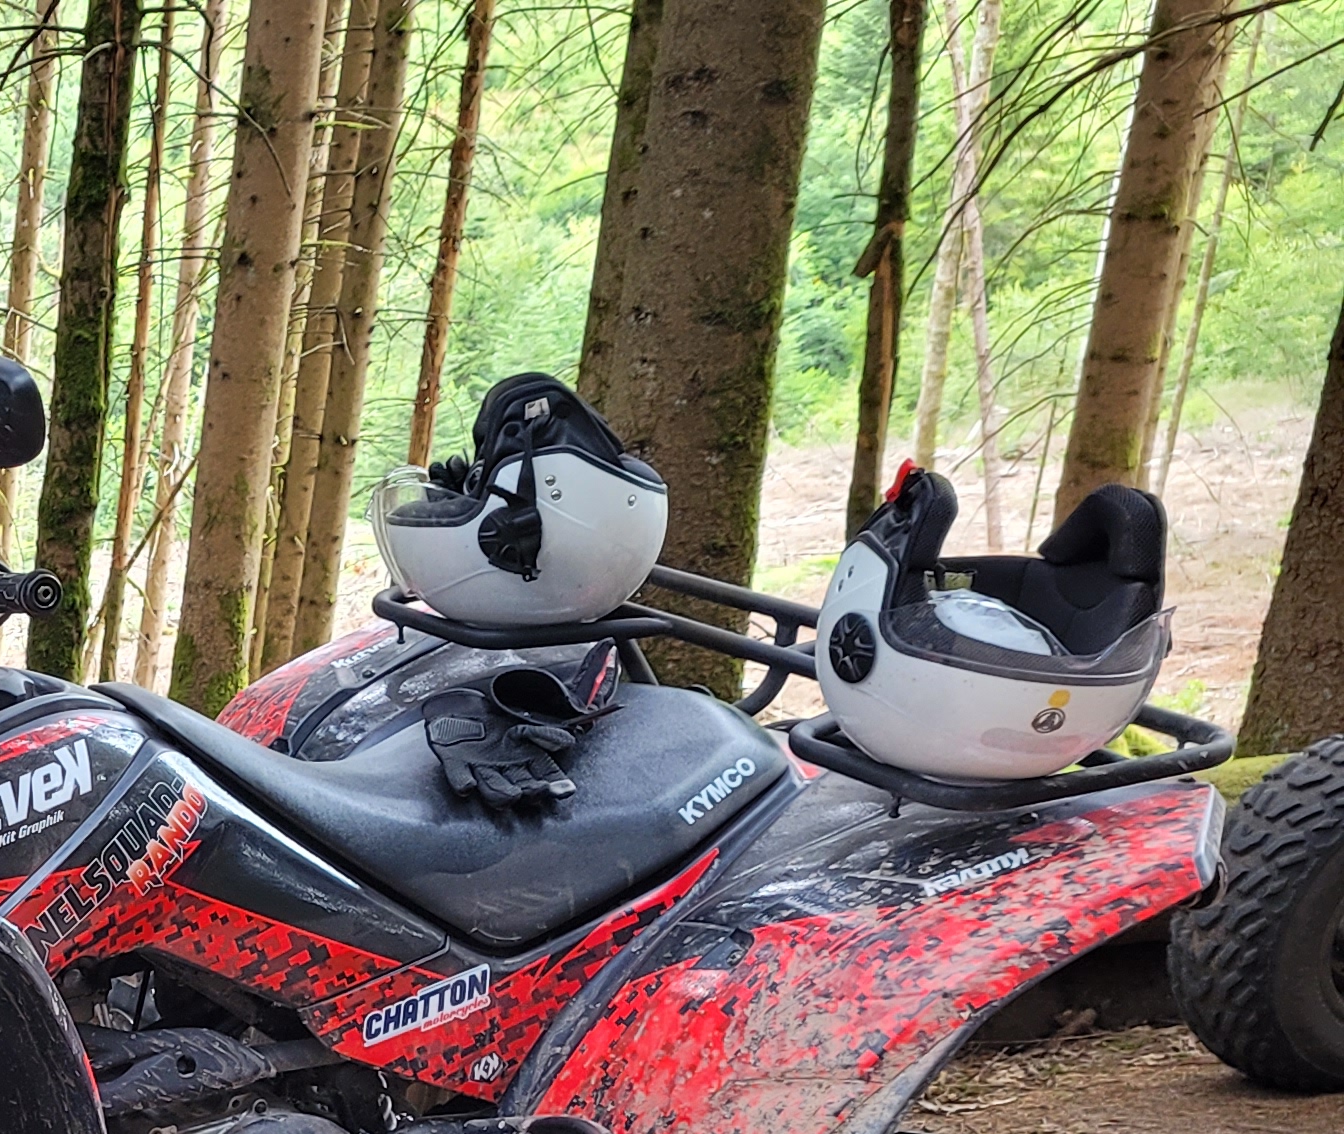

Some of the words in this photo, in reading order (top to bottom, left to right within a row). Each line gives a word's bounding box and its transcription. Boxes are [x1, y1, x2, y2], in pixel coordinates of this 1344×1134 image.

[18, 810, 66, 838] Graphik
[678, 757, 756, 825] KYMCO
[125, 782, 208, 897] RANDO
[366, 969, 488, 1041] CHATTON
[423, 995, 490, 1030] motorcycles
